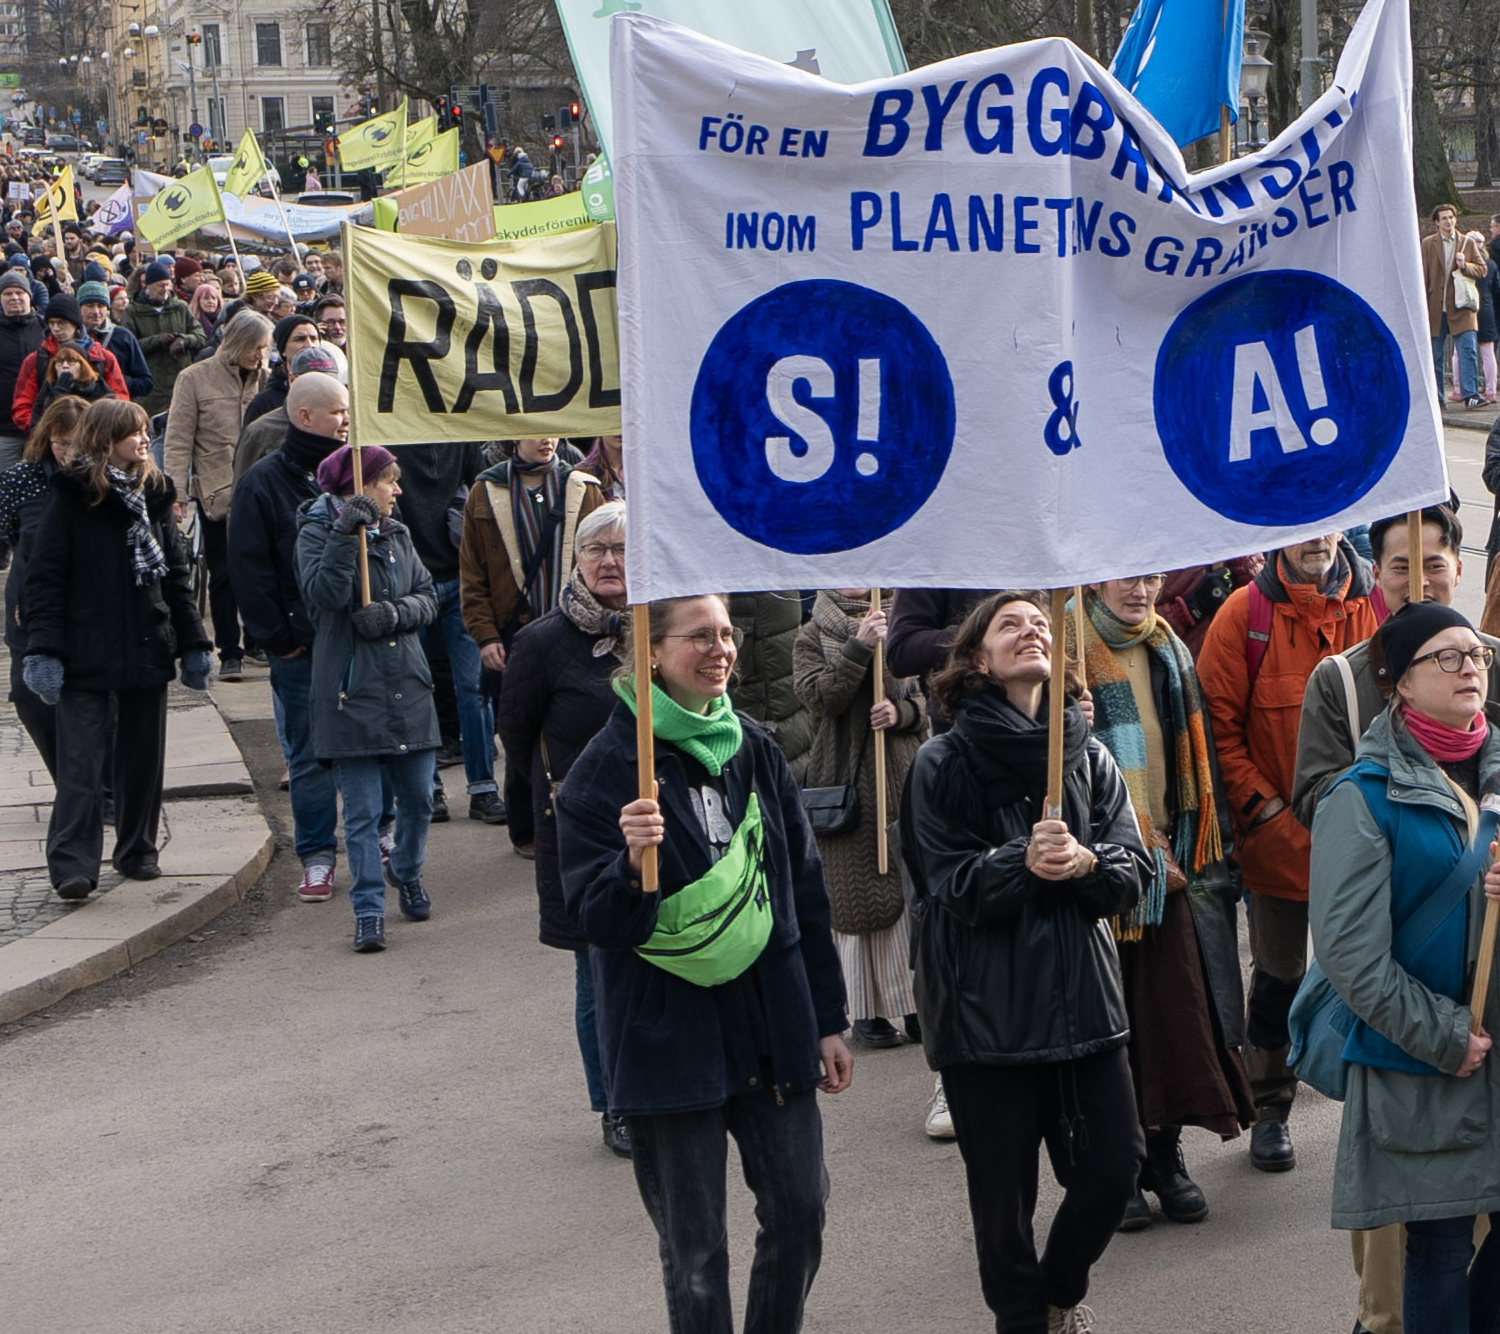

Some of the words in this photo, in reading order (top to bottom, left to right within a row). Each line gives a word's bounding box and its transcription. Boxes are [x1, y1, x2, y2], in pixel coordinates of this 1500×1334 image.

[700, 112, 768, 156] FÖR
[780, 127, 828, 158] EN
[725, 211, 817, 252] INOM
[851, 190, 1137, 257] PLANETENS
[764, 353, 881, 483] S!
[1044, 359, 1082, 456] &
[1228, 324, 1339, 463] A!
